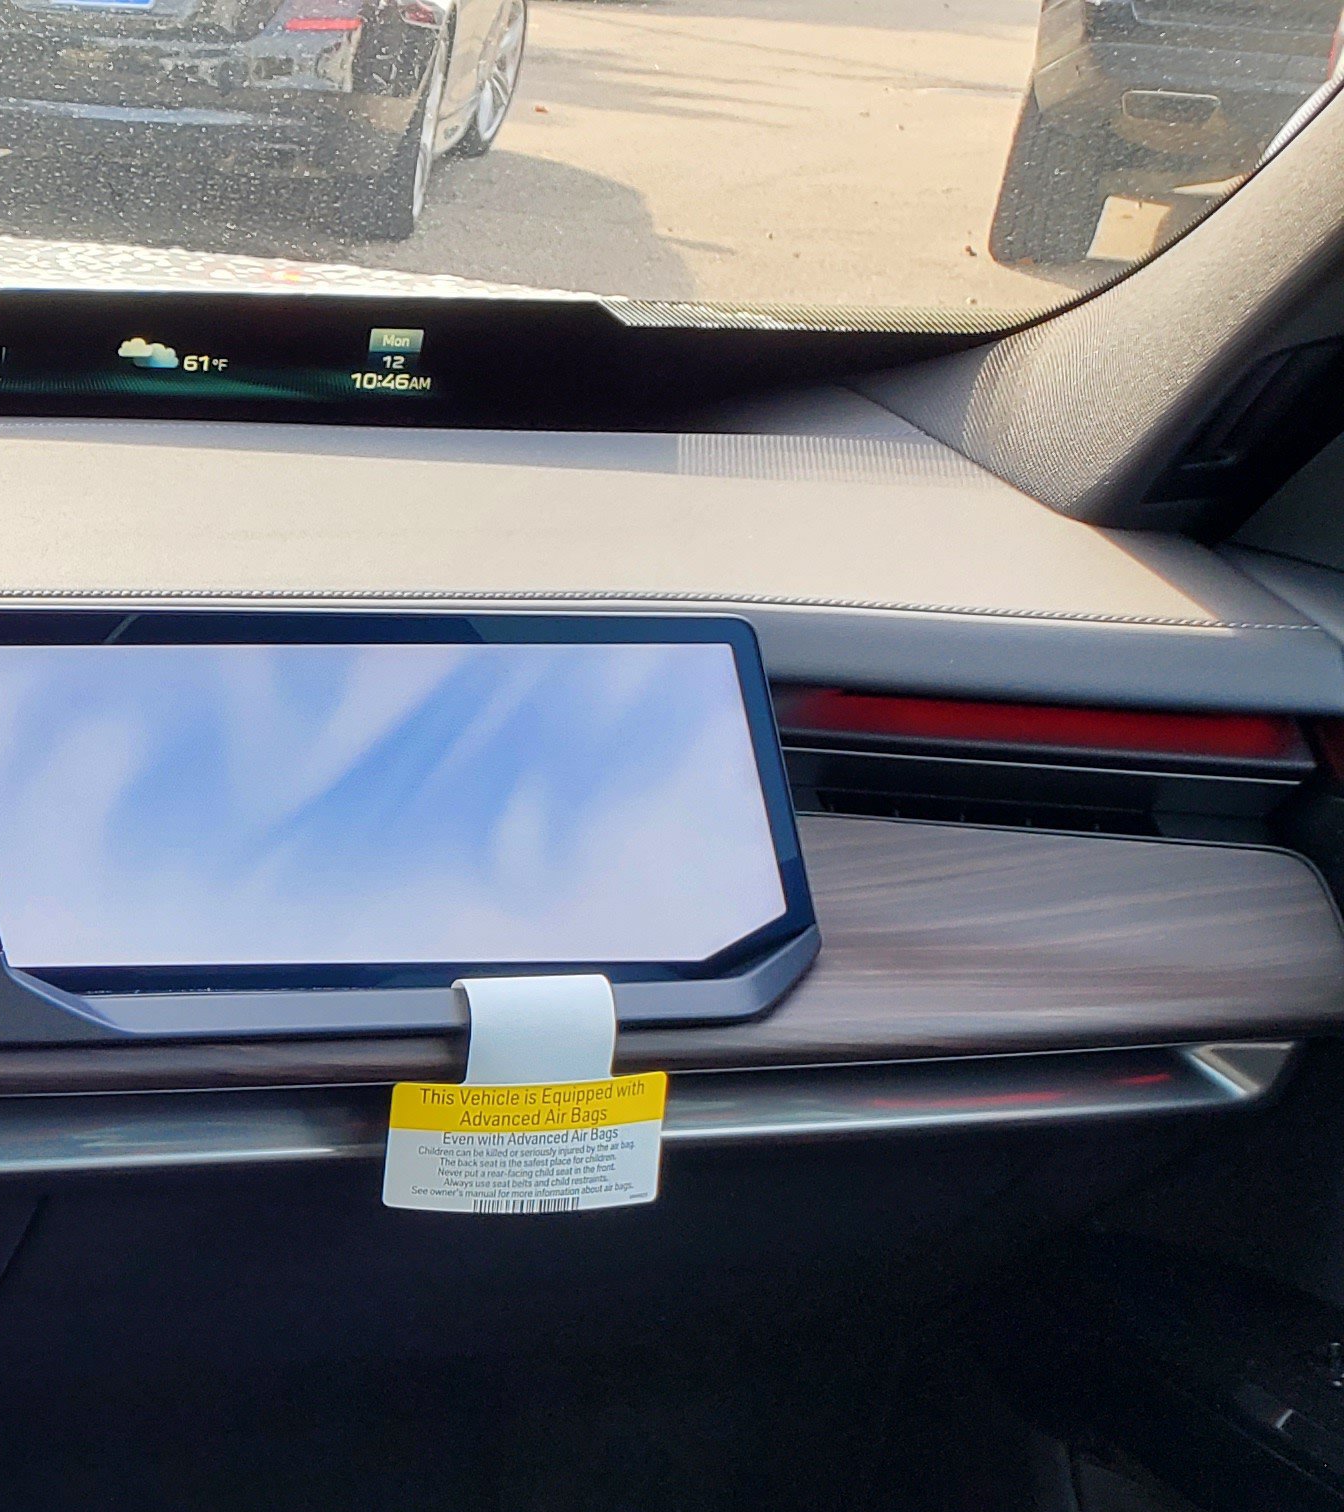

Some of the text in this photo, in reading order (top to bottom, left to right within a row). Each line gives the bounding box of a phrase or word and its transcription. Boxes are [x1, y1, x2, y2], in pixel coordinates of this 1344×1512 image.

[382, 334, 410, 347] Mon
[382, 355, 405, 369] 12
[420, 1080, 645, 1106] This Vehicle is Equipped with
[460, 1107, 607, 1126] Advanced Air Bags
[443, 1128, 619, 1146] Even with Advanced Air Bags
[418, 1146, 454, 1156] Children
[456, 1149, 471, 1157] can
[473, 1148, 484, 1157] be
[486, 1148, 508, 1157] killed
[520, 1147, 556, 1158] seriously
[558, 1146, 585, 1157] injured
[586, 1144, 595, 1154] by
[597, 1143, 609, 1152] the
[610, 1142, 619, 1150] air
[440, 1157, 456, 1166] The
[458, 1158, 478, 1167] back
[480, 1159, 498, 1168] seat
[499, 1159, 506, 1167] is
[508, 1158, 522, 1167] the
[523, 1158, 548, 1167] safest
[550, 1157, 571, 1169] place
[573, 1156, 583, 1165] for
[438, 1167, 462, 1176] Never
[464, 1168, 478, 1178] put
[487, 1168, 533, 1178] rear-facing
[535, 1166, 554, 1177] child
[556, 1167, 573, 1176] seat
[583, 1164, 595, 1173] the
[443, 1178, 473, 1189] Always
[475, 1180, 490, 1188] use
[492, 1180, 510, 1188] seat
[512, 1179, 532, 1188] belts
[534, 1178, 550, 1187] and
[552, 1176, 570, 1186] child
[411, 1185, 428, 1195] See
[430, 1188, 463, 1197] owner's
[465, 1188, 496, 1197] manual
[497, 1189, 510, 1198] for
[511, 1190, 532, 1198] more
[534, 1187, 580, 1197] information
[581, 1184, 603, 1194] about
[604, 1183, 613, 1191] air
